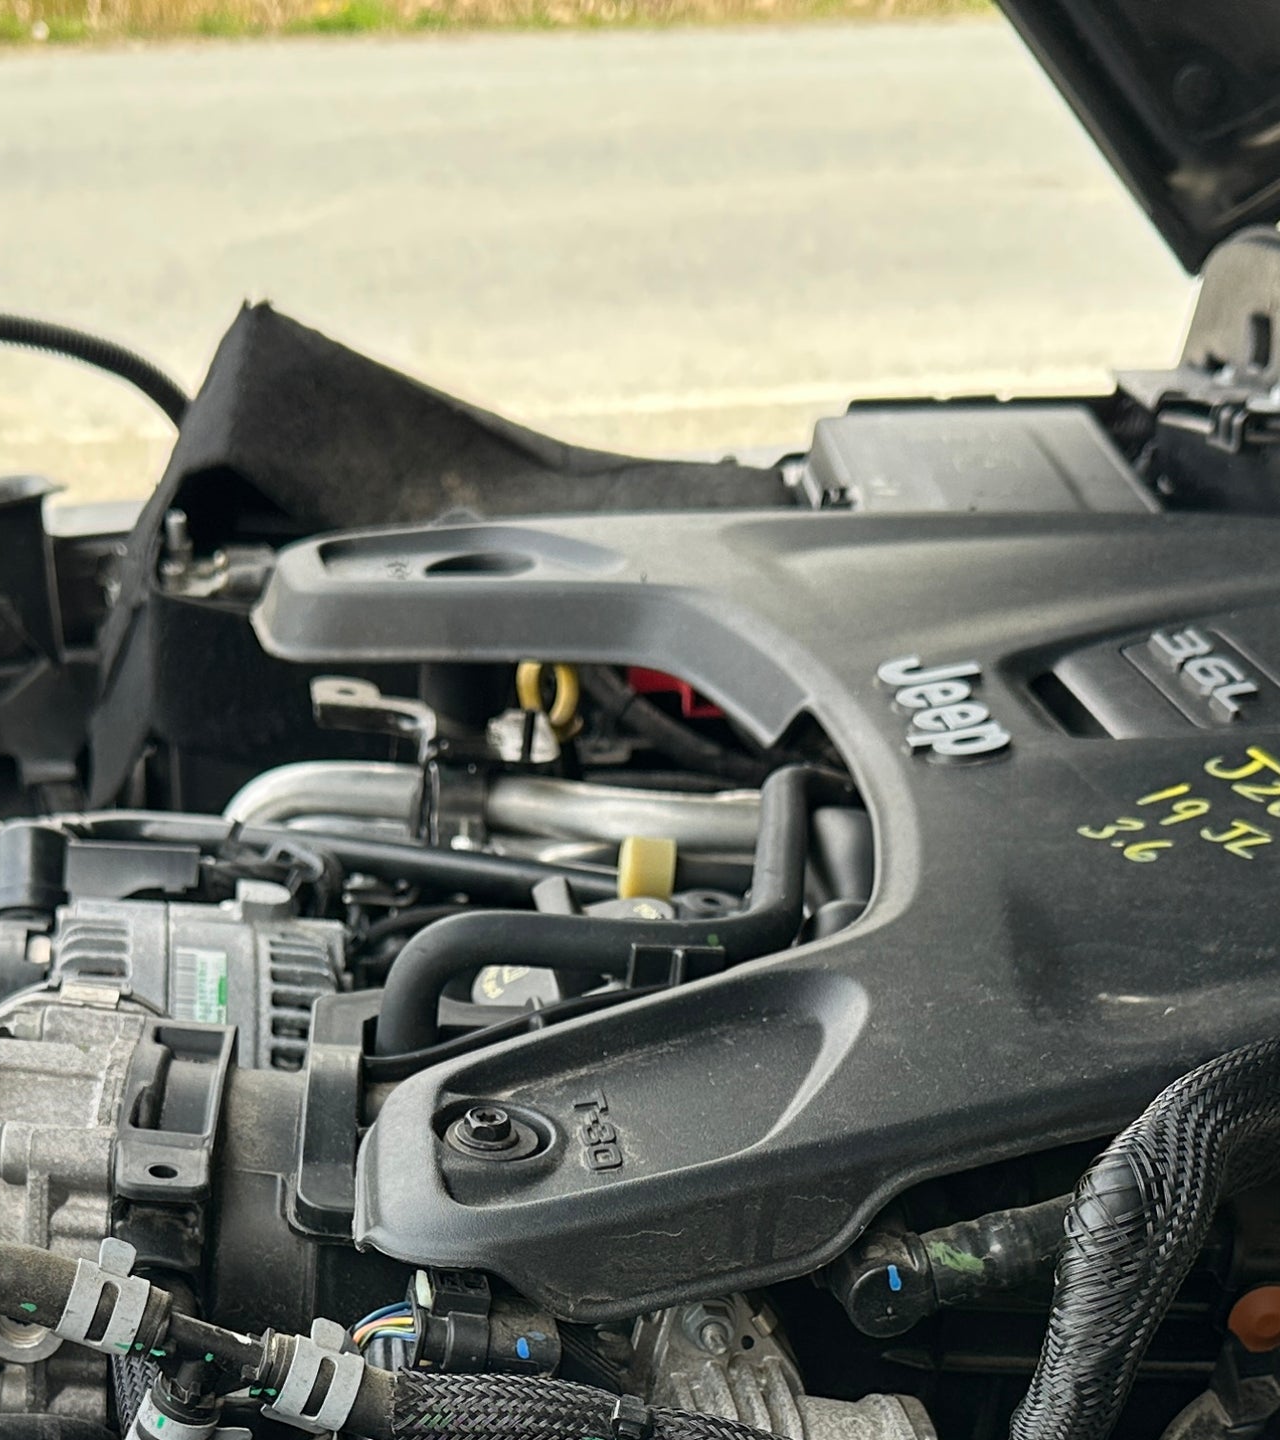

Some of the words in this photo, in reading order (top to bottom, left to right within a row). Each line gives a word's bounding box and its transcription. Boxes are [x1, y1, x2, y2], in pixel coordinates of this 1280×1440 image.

[877, 654, 1012, 757] Jeep
[1137, 782, 1211, 826] 19
[1077, 817, 1173, 863] 3.6
[572, 1089, 624, 1174] T-30
